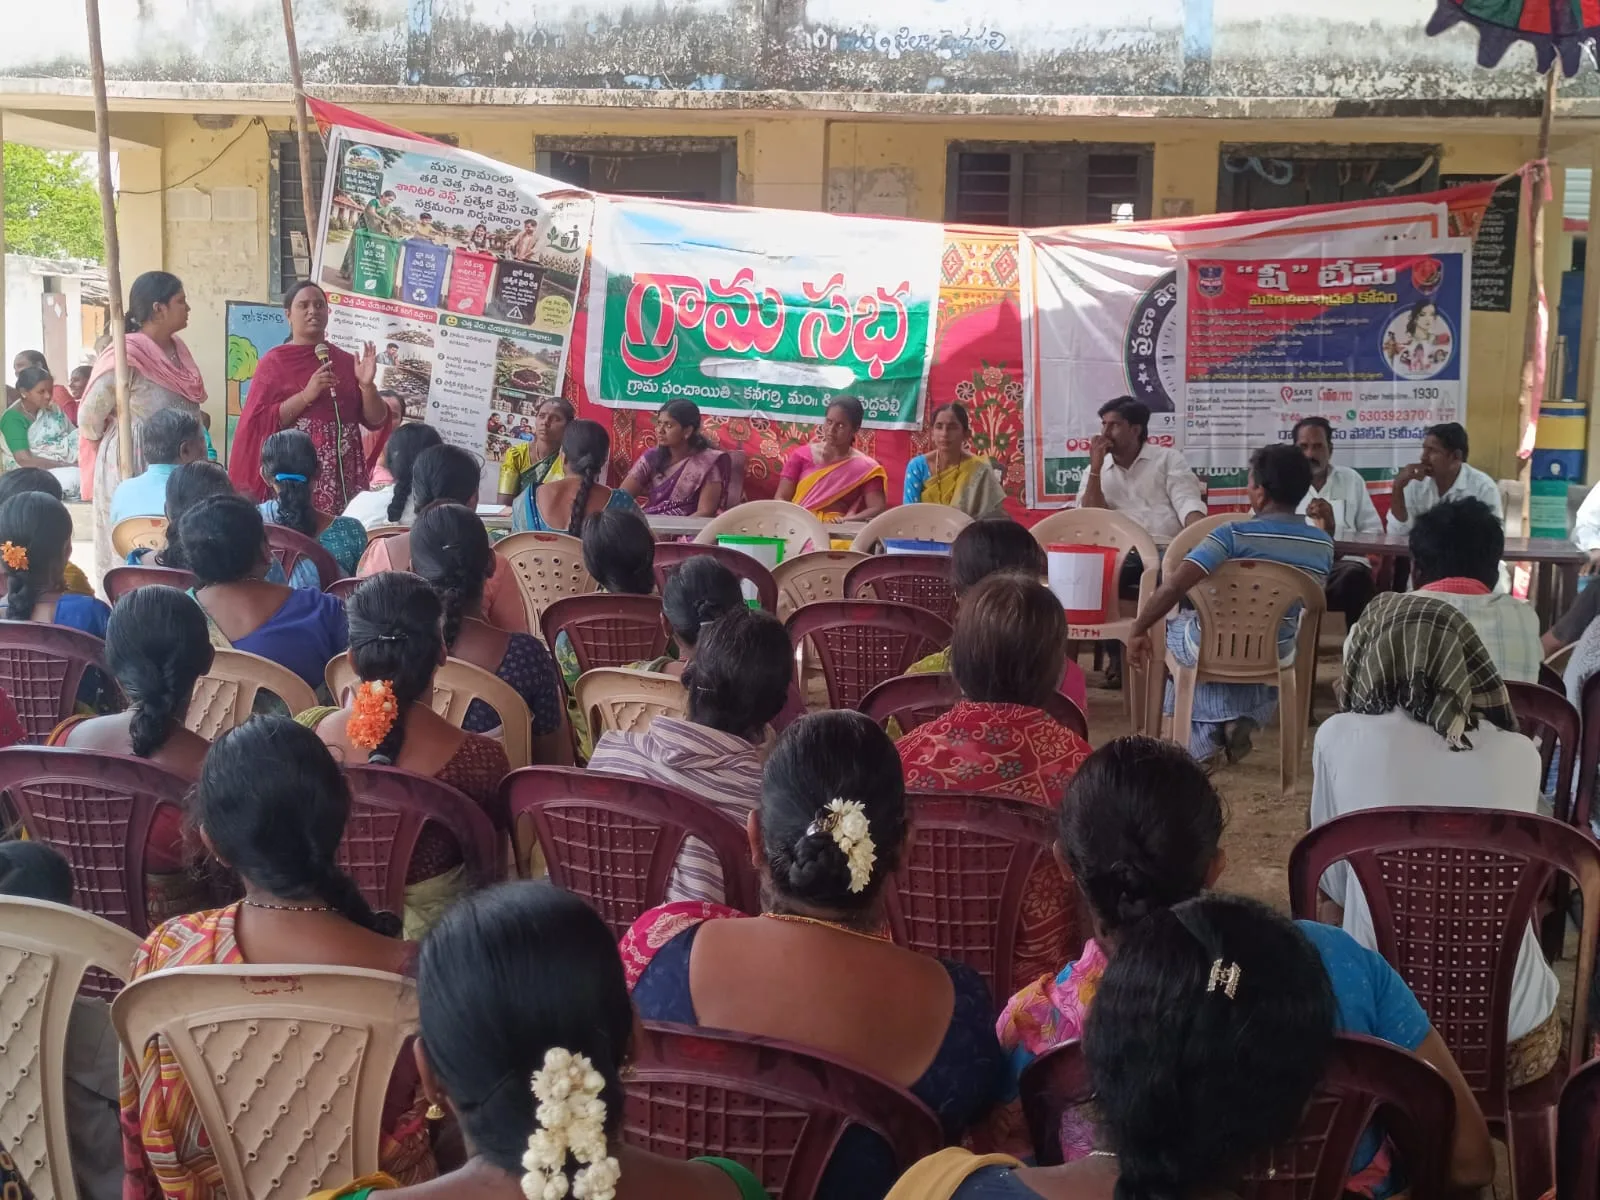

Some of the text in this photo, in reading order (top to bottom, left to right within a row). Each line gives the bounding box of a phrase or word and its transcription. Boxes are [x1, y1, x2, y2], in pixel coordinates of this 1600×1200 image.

[430, 161, 457, 174] మన
[415, 199, 464, 215] సక్రమంగా
[620, 267, 911, 379] గ్రామ సభ
[627, 379, 658, 395] గ్రామ
[1413, 387, 1439, 400] 1930
